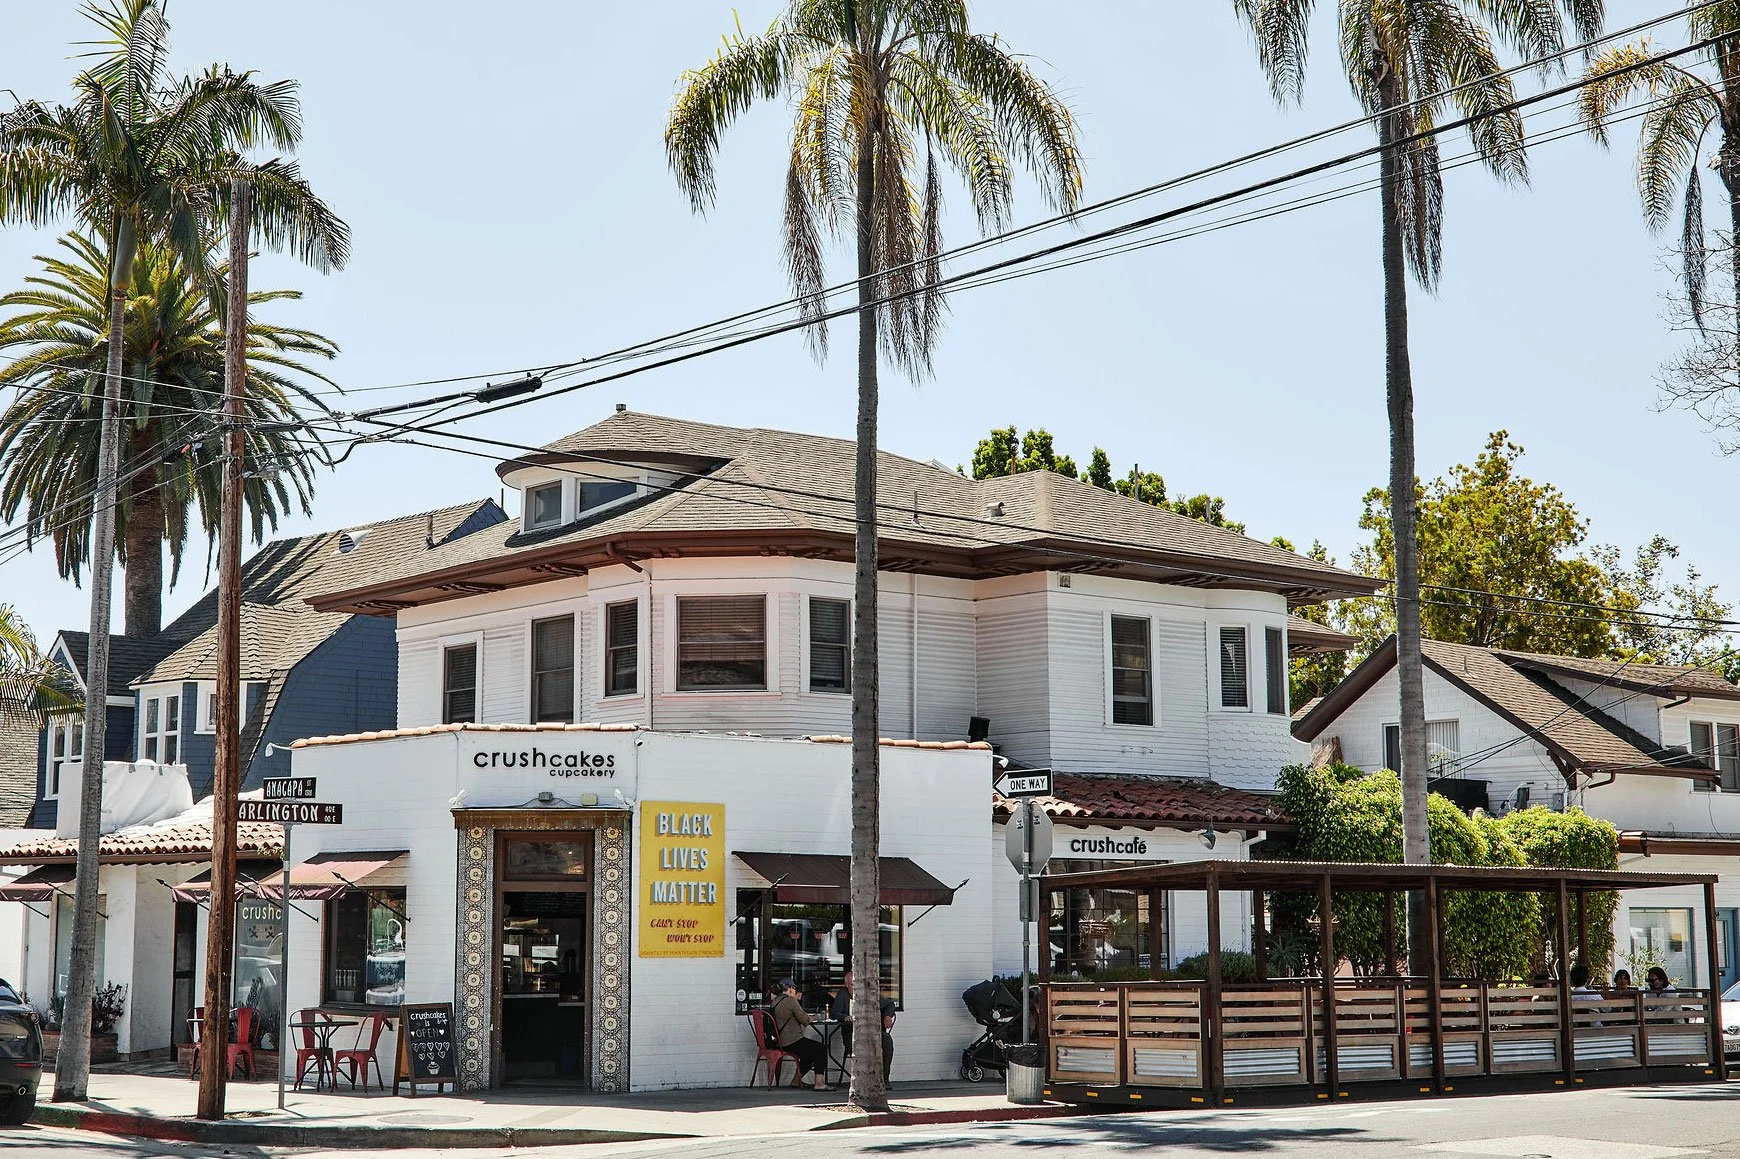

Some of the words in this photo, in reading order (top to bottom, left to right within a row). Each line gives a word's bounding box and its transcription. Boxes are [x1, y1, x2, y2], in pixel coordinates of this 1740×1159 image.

[473, 747, 615, 768] crushcakes
[549, 767, 615, 778] cupcakery
[266, 780, 303, 797] ANACAPA
[1010, 780, 1027, 790] ONE
[1028, 777, 1046, 789] WAY
[238, 802, 320, 822] ARLINGTON
[656, 813, 713, 837] BLACK
[1070, 836, 1147, 855] crushcafé
[660, 847, 709, 870] LIVES
[651, 880, 717, 905] MATTER
[242, 903, 282, 920] crushc
[650, 918, 674, 928] CAN'T
[676, 918, 699, 929] STOP
[667, 933, 692, 943] WON'T
[693, 934, 715, 943] STOP
[410, 1011, 446, 1020] crushcakes
[416, 1028, 439, 1038] OPEN
